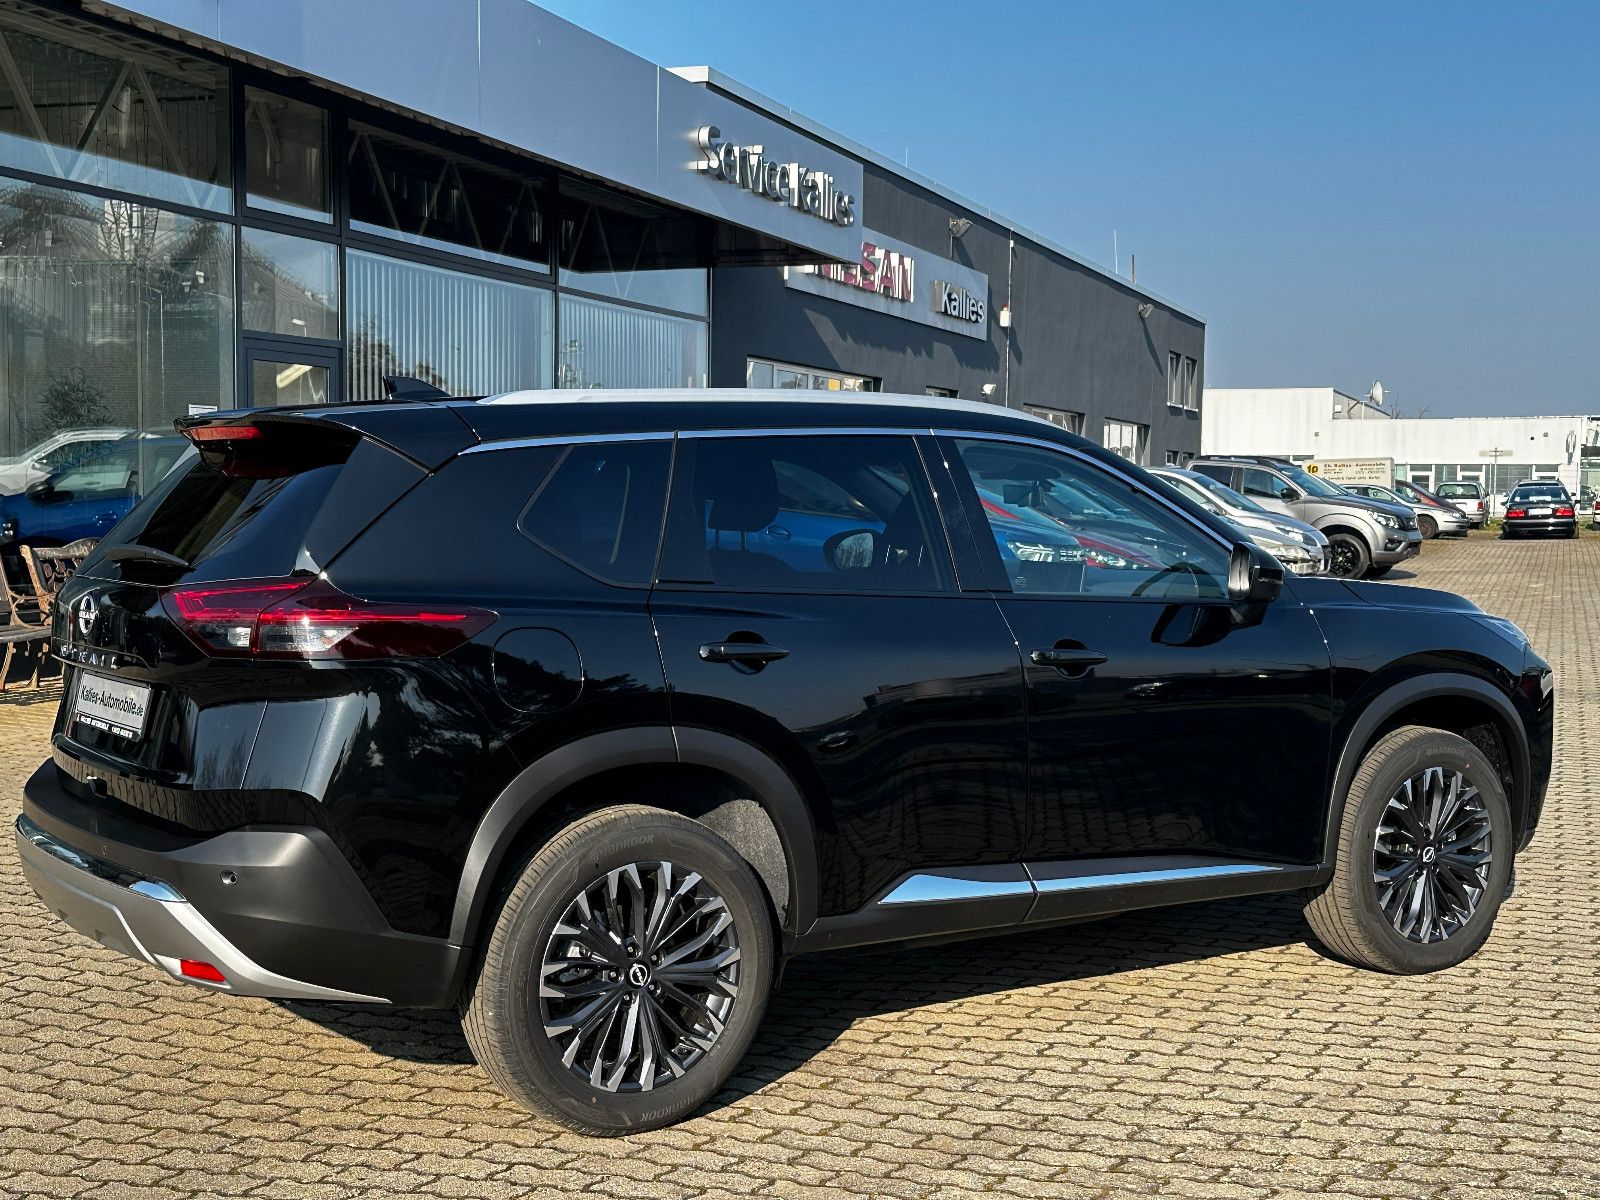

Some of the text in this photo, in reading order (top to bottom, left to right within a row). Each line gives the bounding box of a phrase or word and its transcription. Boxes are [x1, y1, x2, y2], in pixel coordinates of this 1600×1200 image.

[696, 125, 855, 227] Service Kallies
[934, 279, 986, 324] Kallies
